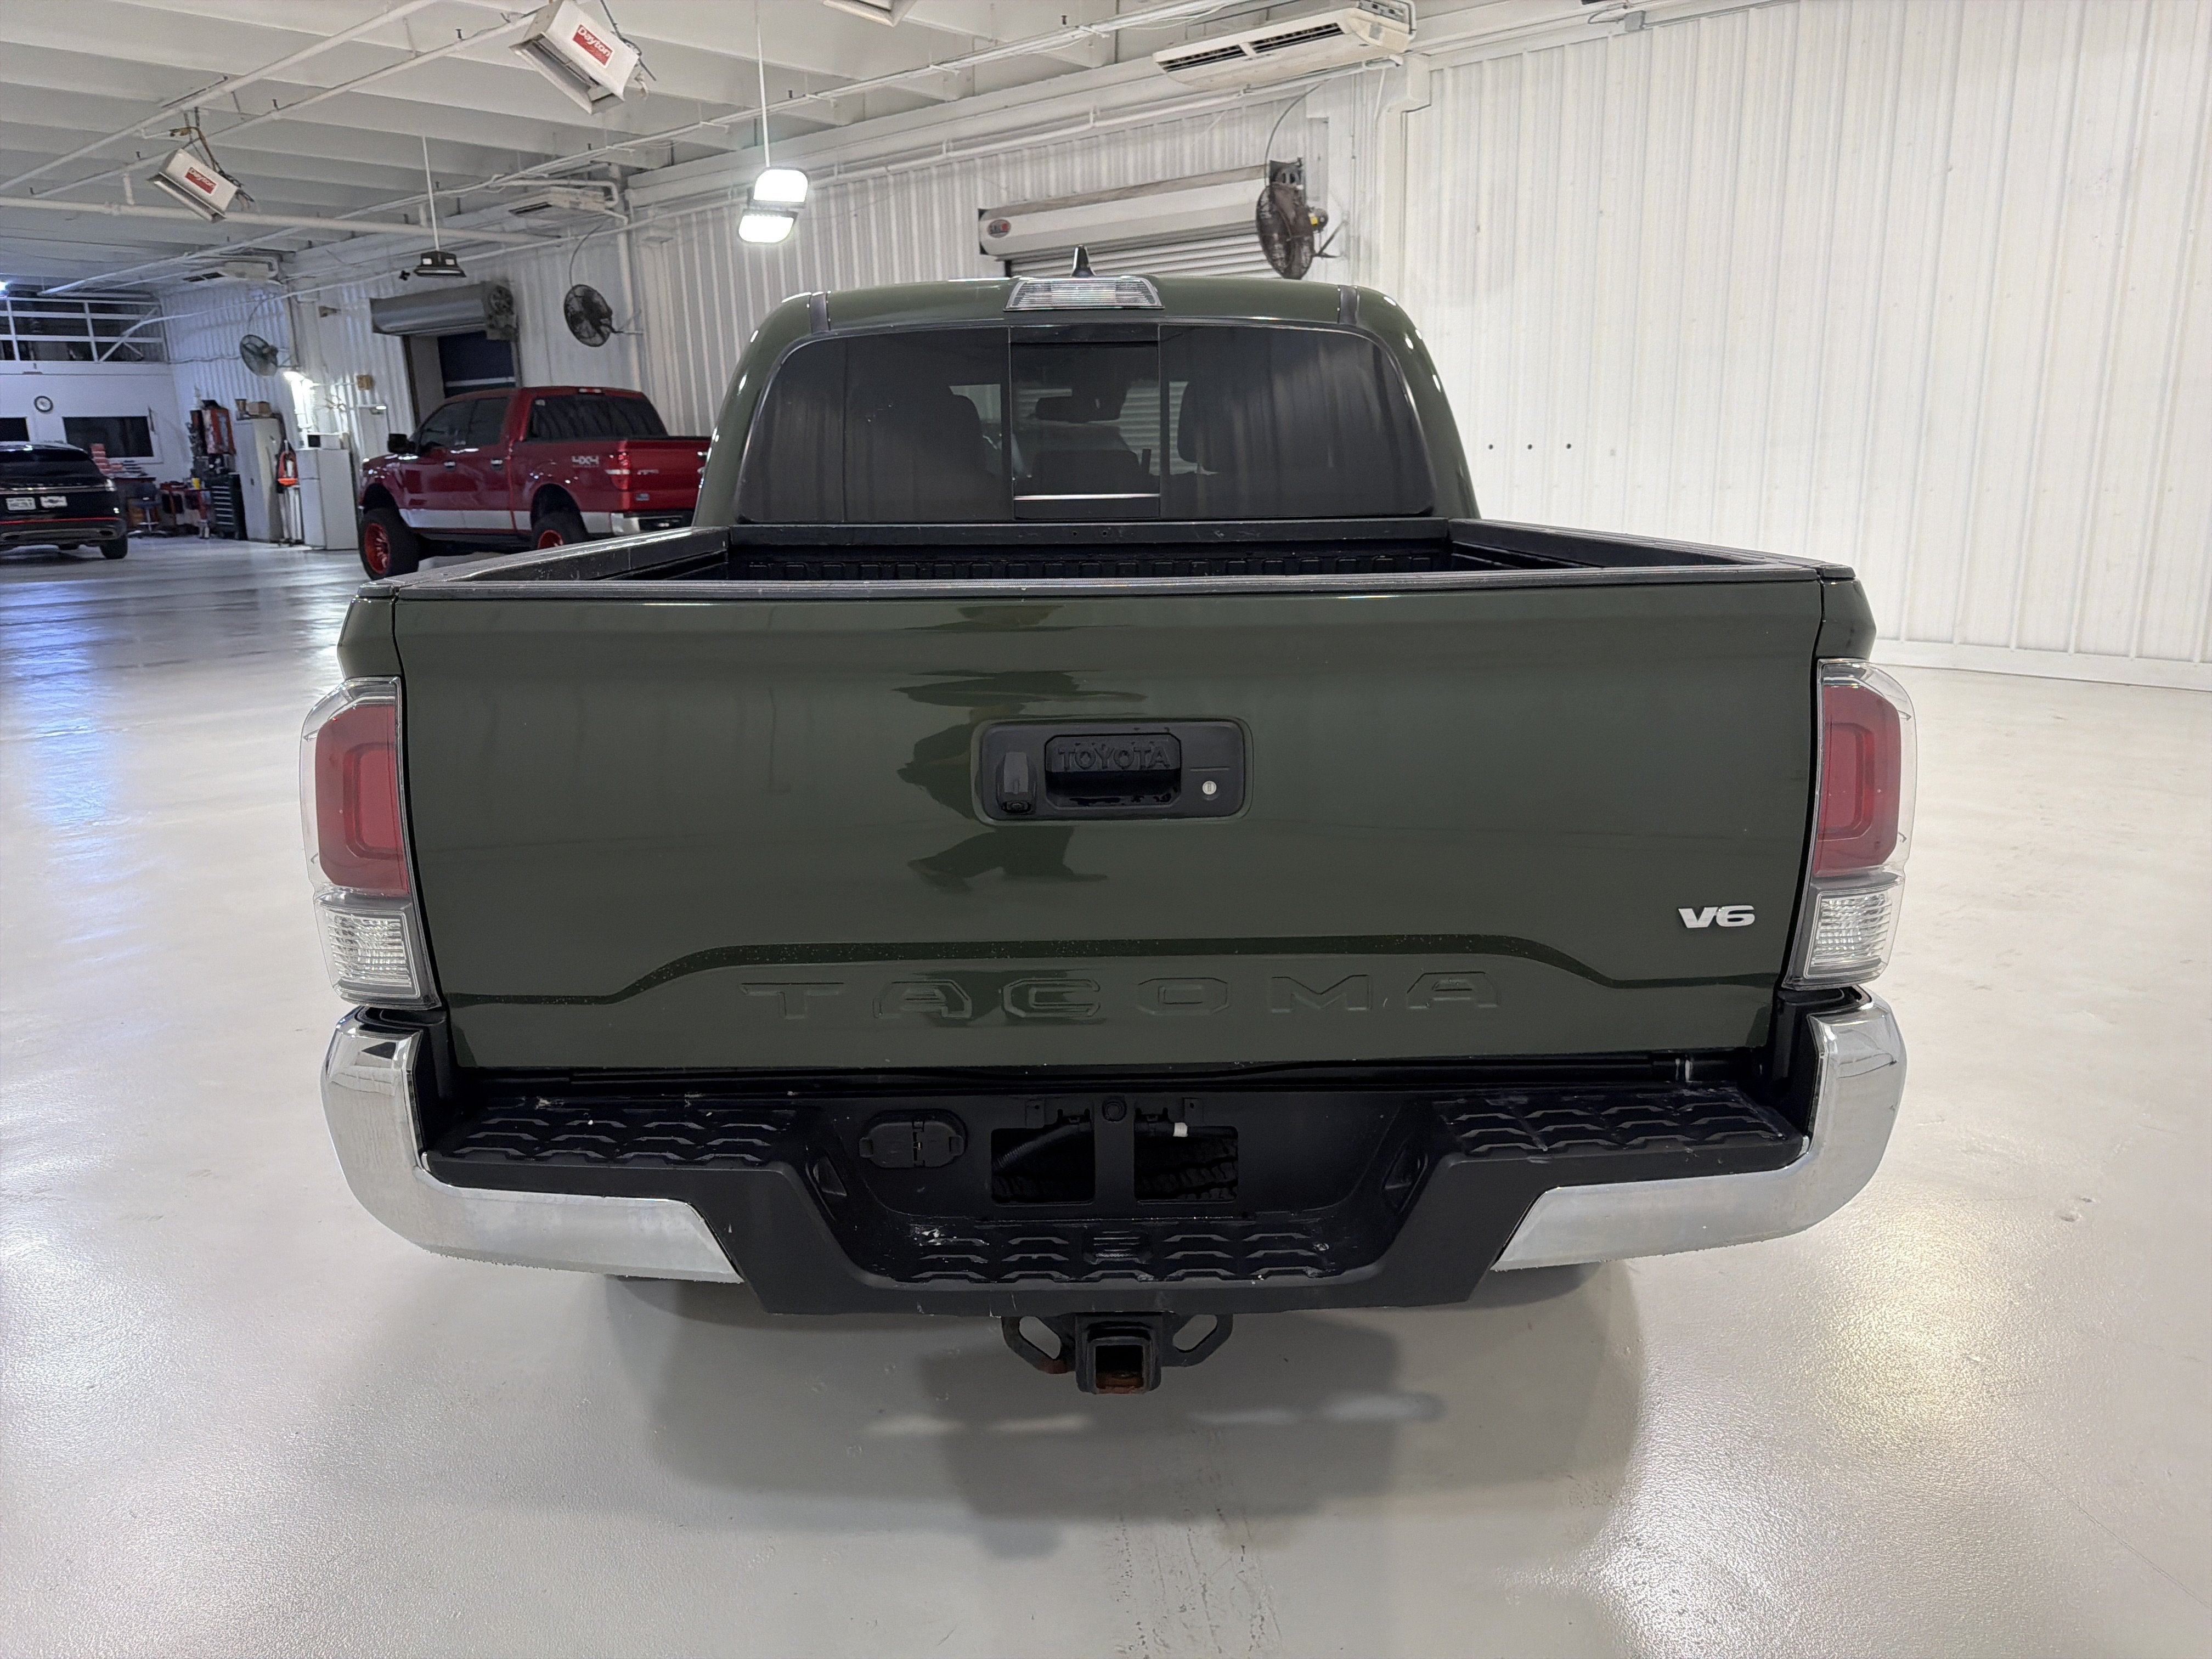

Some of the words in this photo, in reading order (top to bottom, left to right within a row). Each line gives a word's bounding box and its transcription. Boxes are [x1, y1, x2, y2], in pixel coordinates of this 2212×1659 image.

[578, 27, 611, 57] Dayton
[1058, 746, 1170, 771] TOYOTA
[1678, 905, 1756, 928] V6
[741, 971, 1498, 1020] TACOMA
